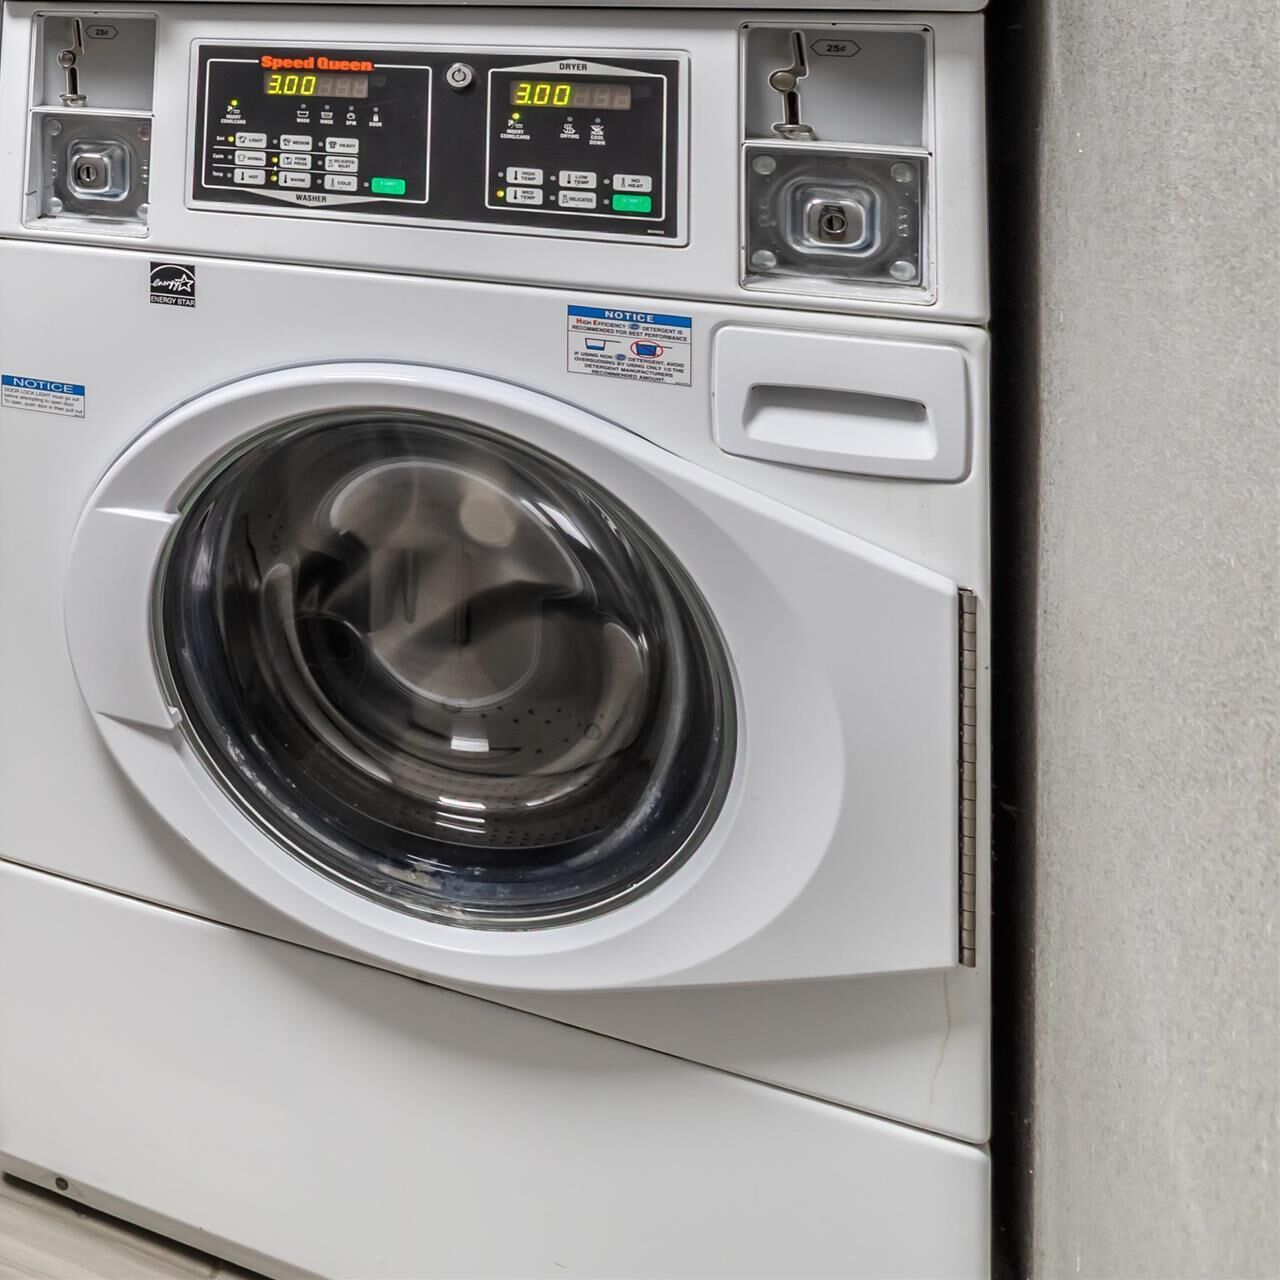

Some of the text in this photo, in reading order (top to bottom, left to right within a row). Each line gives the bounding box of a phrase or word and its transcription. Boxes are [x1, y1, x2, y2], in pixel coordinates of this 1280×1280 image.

[261, 56, 372, 71] Speed Queen
[559, 62, 588, 71] DRYER
[268, 75, 316, 95] 3.00
[516, 83, 571, 105] 3.00
[295, 194, 327, 203] WASHER
[151, 296, 176, 305] ENERGY
[605, 310, 654, 323] NOTICE
[13, 377, 73, 393] NOTICE
